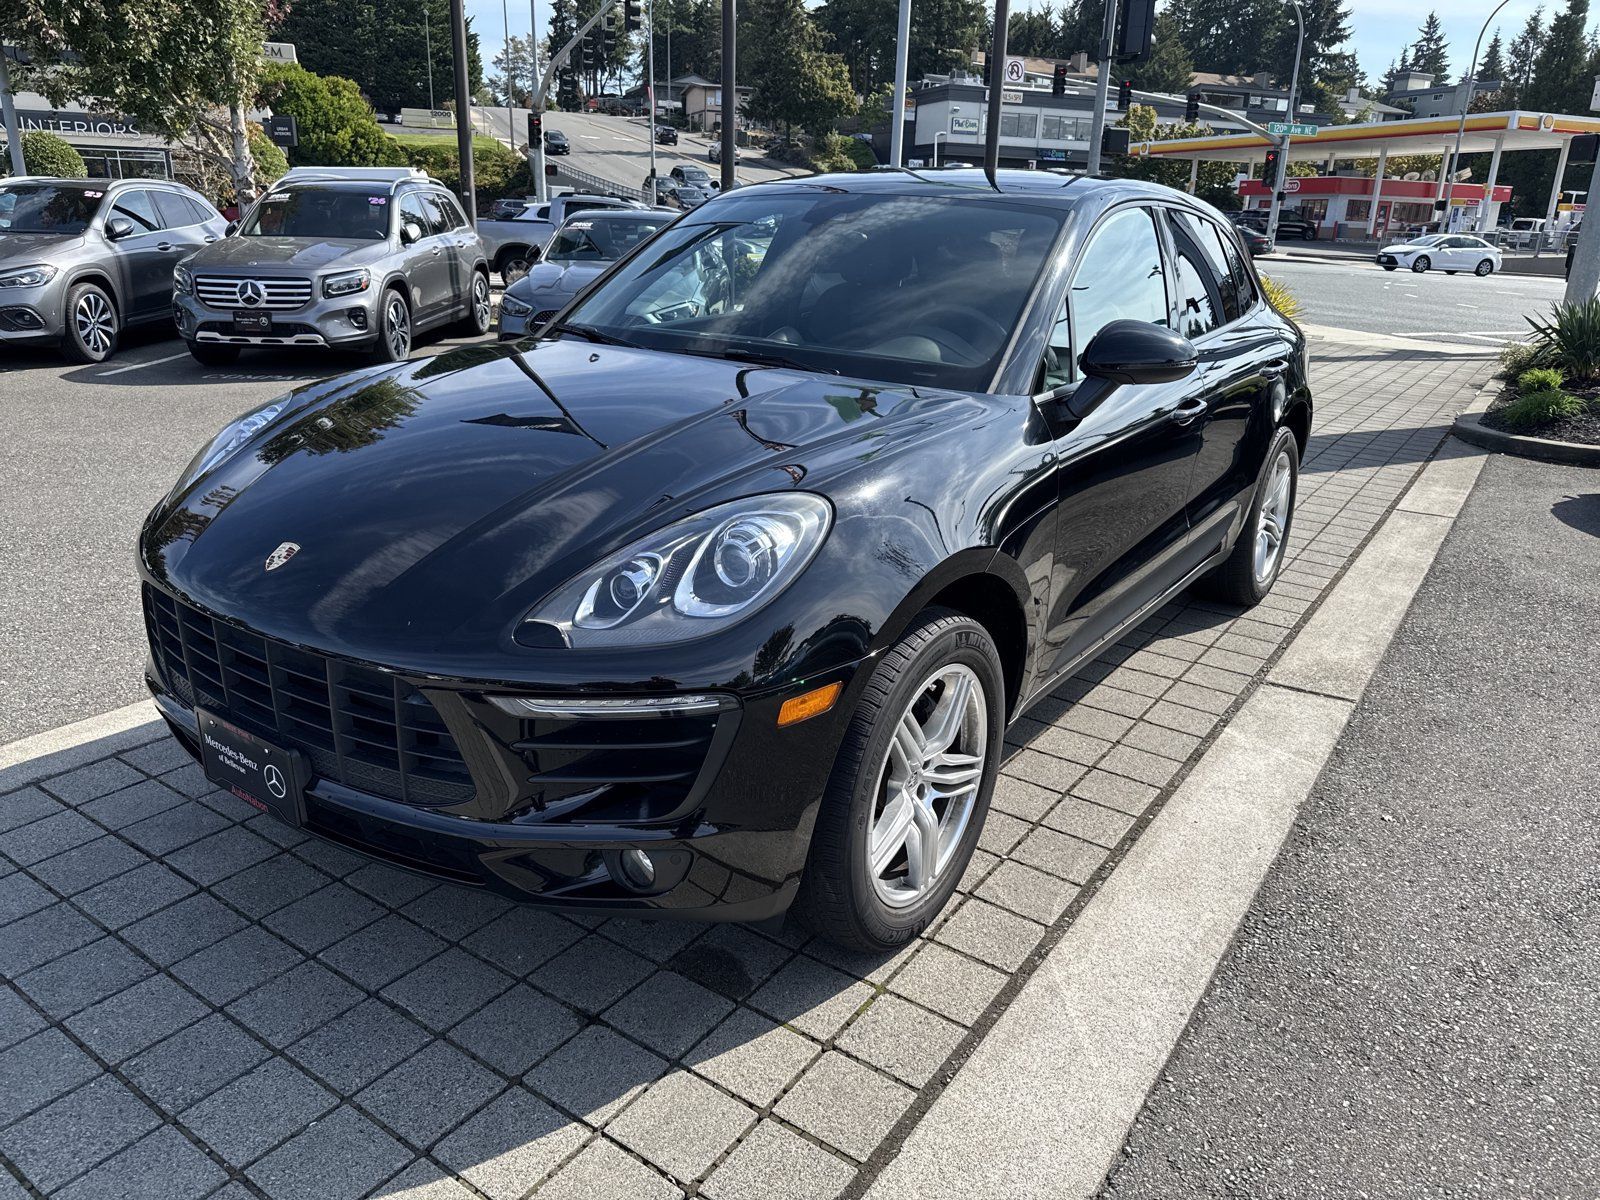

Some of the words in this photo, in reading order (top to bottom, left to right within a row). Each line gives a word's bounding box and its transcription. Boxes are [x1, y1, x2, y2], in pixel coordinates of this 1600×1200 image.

[20, 116, 141, 139] INTERIORS
[1290, 125, 1302, 135] Ave
[1304, 126, 1313, 135] NE
[204, 733, 259, 771] Mercedes-Benz
[231, 785, 269, 813] AutoNation
